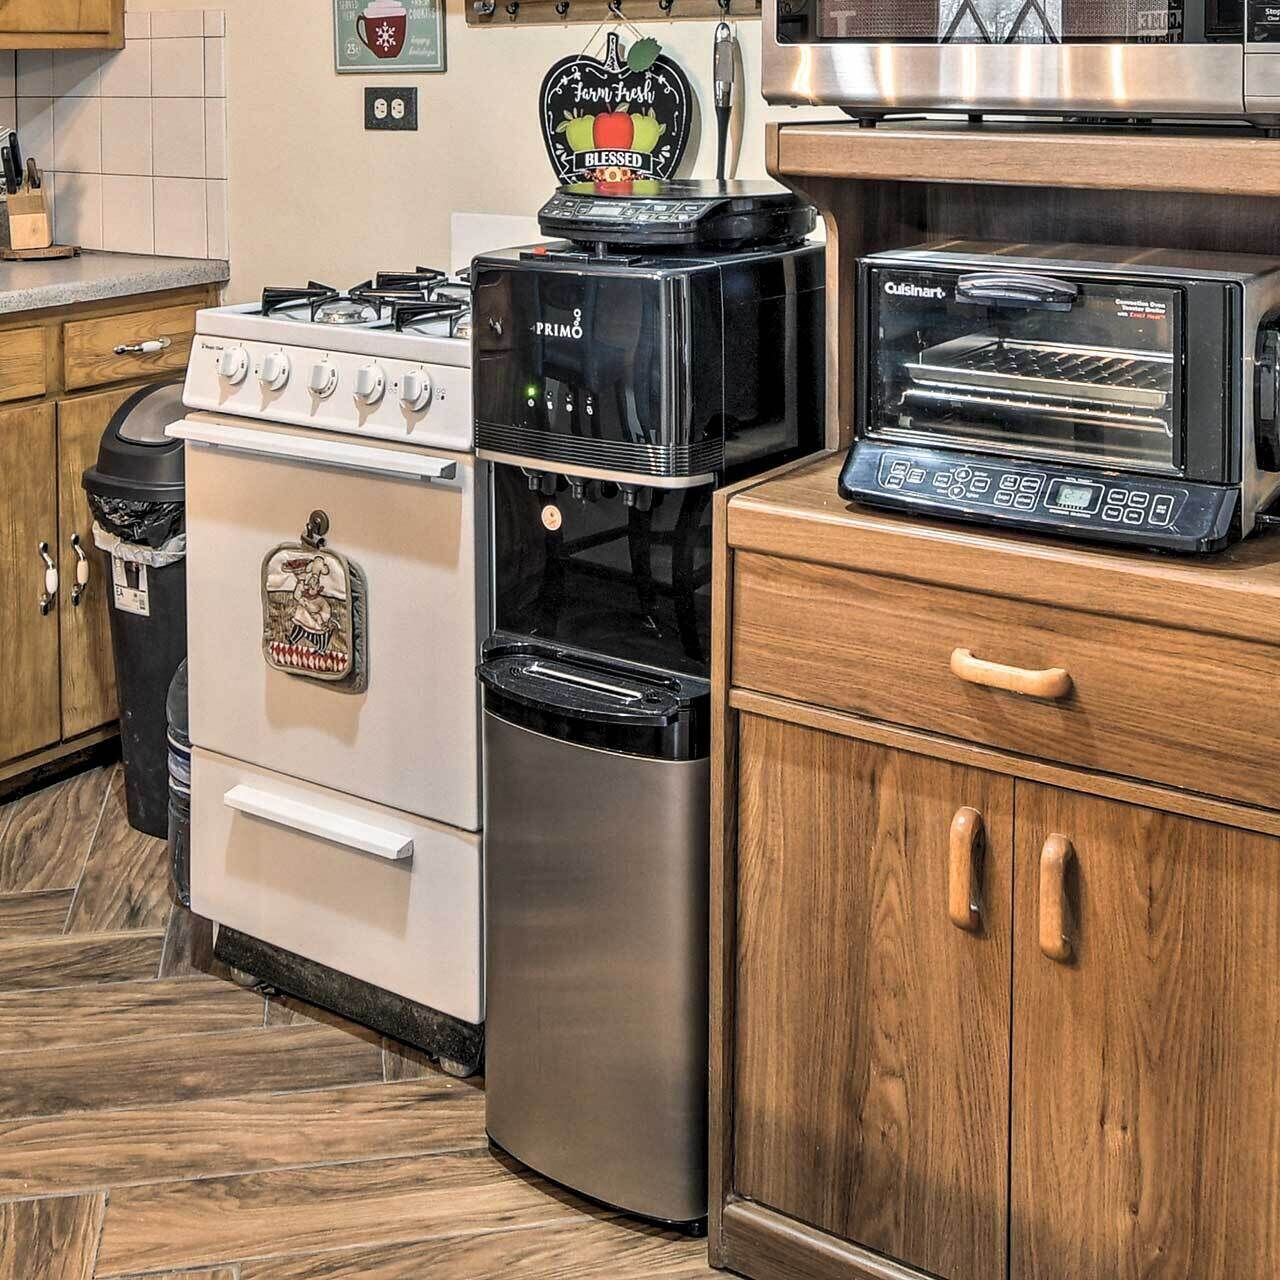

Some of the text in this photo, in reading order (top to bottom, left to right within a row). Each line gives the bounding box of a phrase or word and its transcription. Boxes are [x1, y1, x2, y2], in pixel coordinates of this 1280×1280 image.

[571, 79, 656, 104] Farm Fresh
[584, 150, 643, 168] BLESSED
[884, 281, 942, 299] Cuisinart
[535, 318, 583, 339] PRIMO
